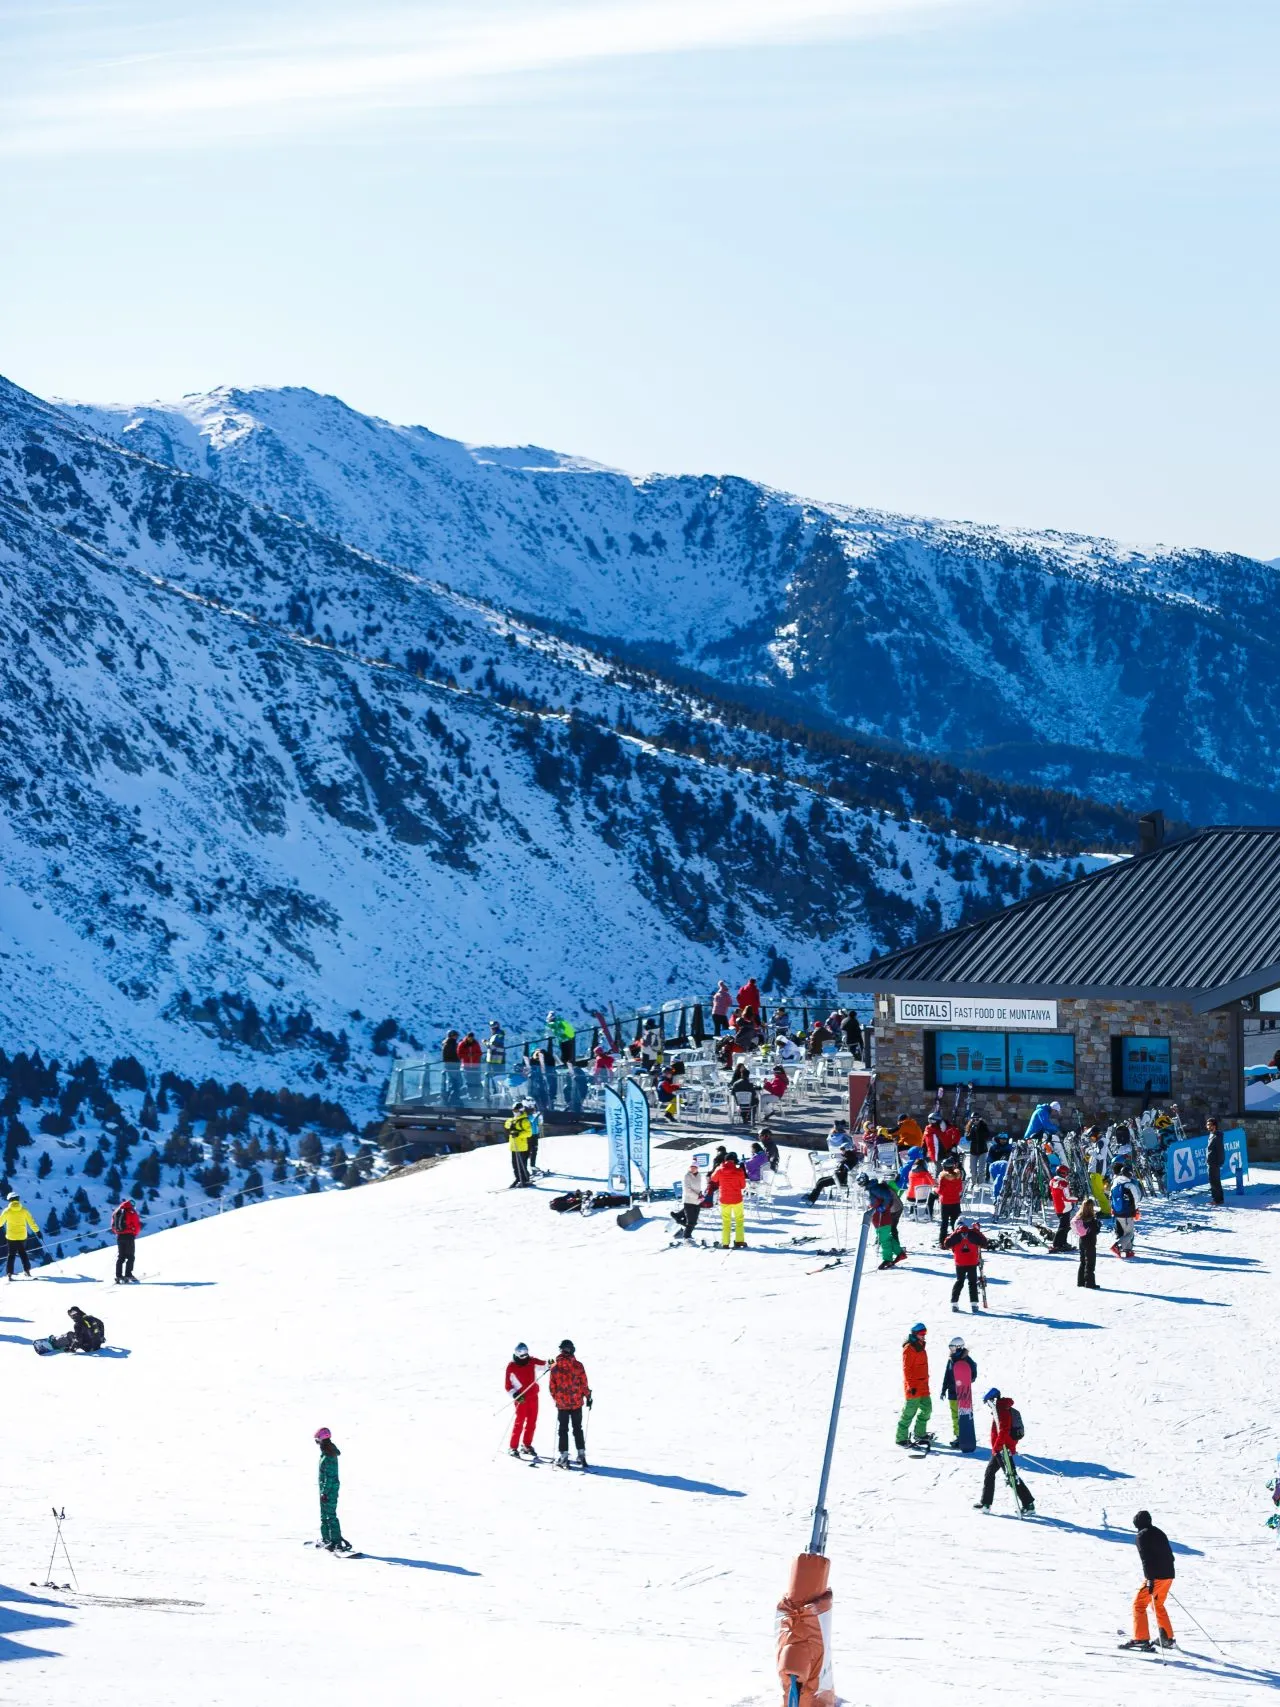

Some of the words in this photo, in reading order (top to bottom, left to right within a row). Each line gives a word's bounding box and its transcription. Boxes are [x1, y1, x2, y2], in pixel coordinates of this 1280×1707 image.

[904, 1003, 948, 1018] CORTALS
[954, 1007, 973, 1019] FAST
[974, 1008, 995, 1019] FOOD
[997, 1008, 1007, 1020] DE
[1009, 1009, 1051, 1021] MUNTANYA
